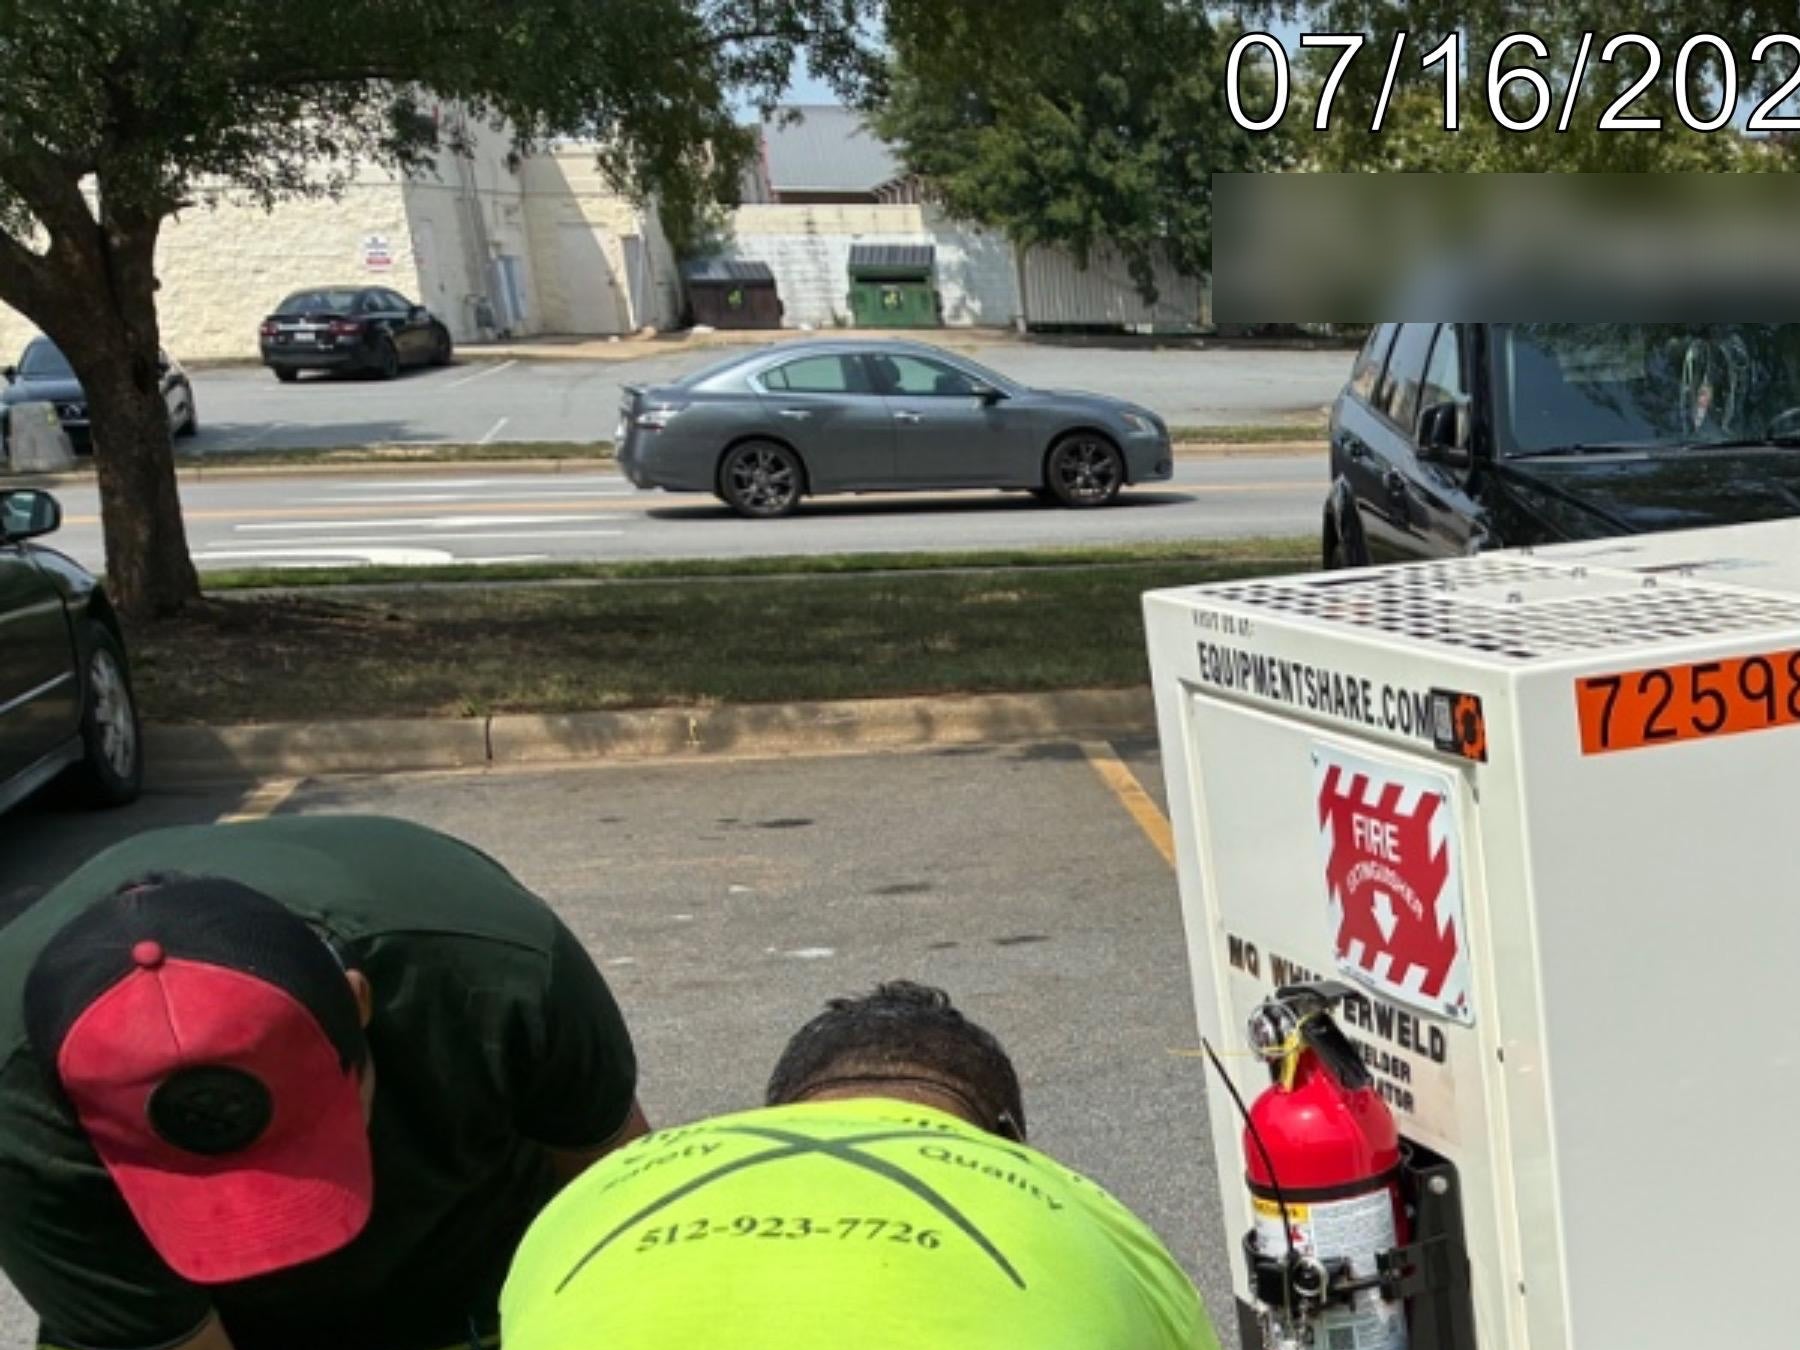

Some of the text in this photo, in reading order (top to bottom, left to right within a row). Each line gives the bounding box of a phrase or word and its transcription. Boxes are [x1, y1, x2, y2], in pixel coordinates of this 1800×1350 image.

[1197, 641, 1437, 740] EQUIPMENTSHARE.COM
[1352, 812, 1402, 863] FIRE
[1227, 933, 1260, 981] MQ
[918, 1145, 1064, 1210] Quality
[636, 1215, 942, 1253] 512-923-7726
